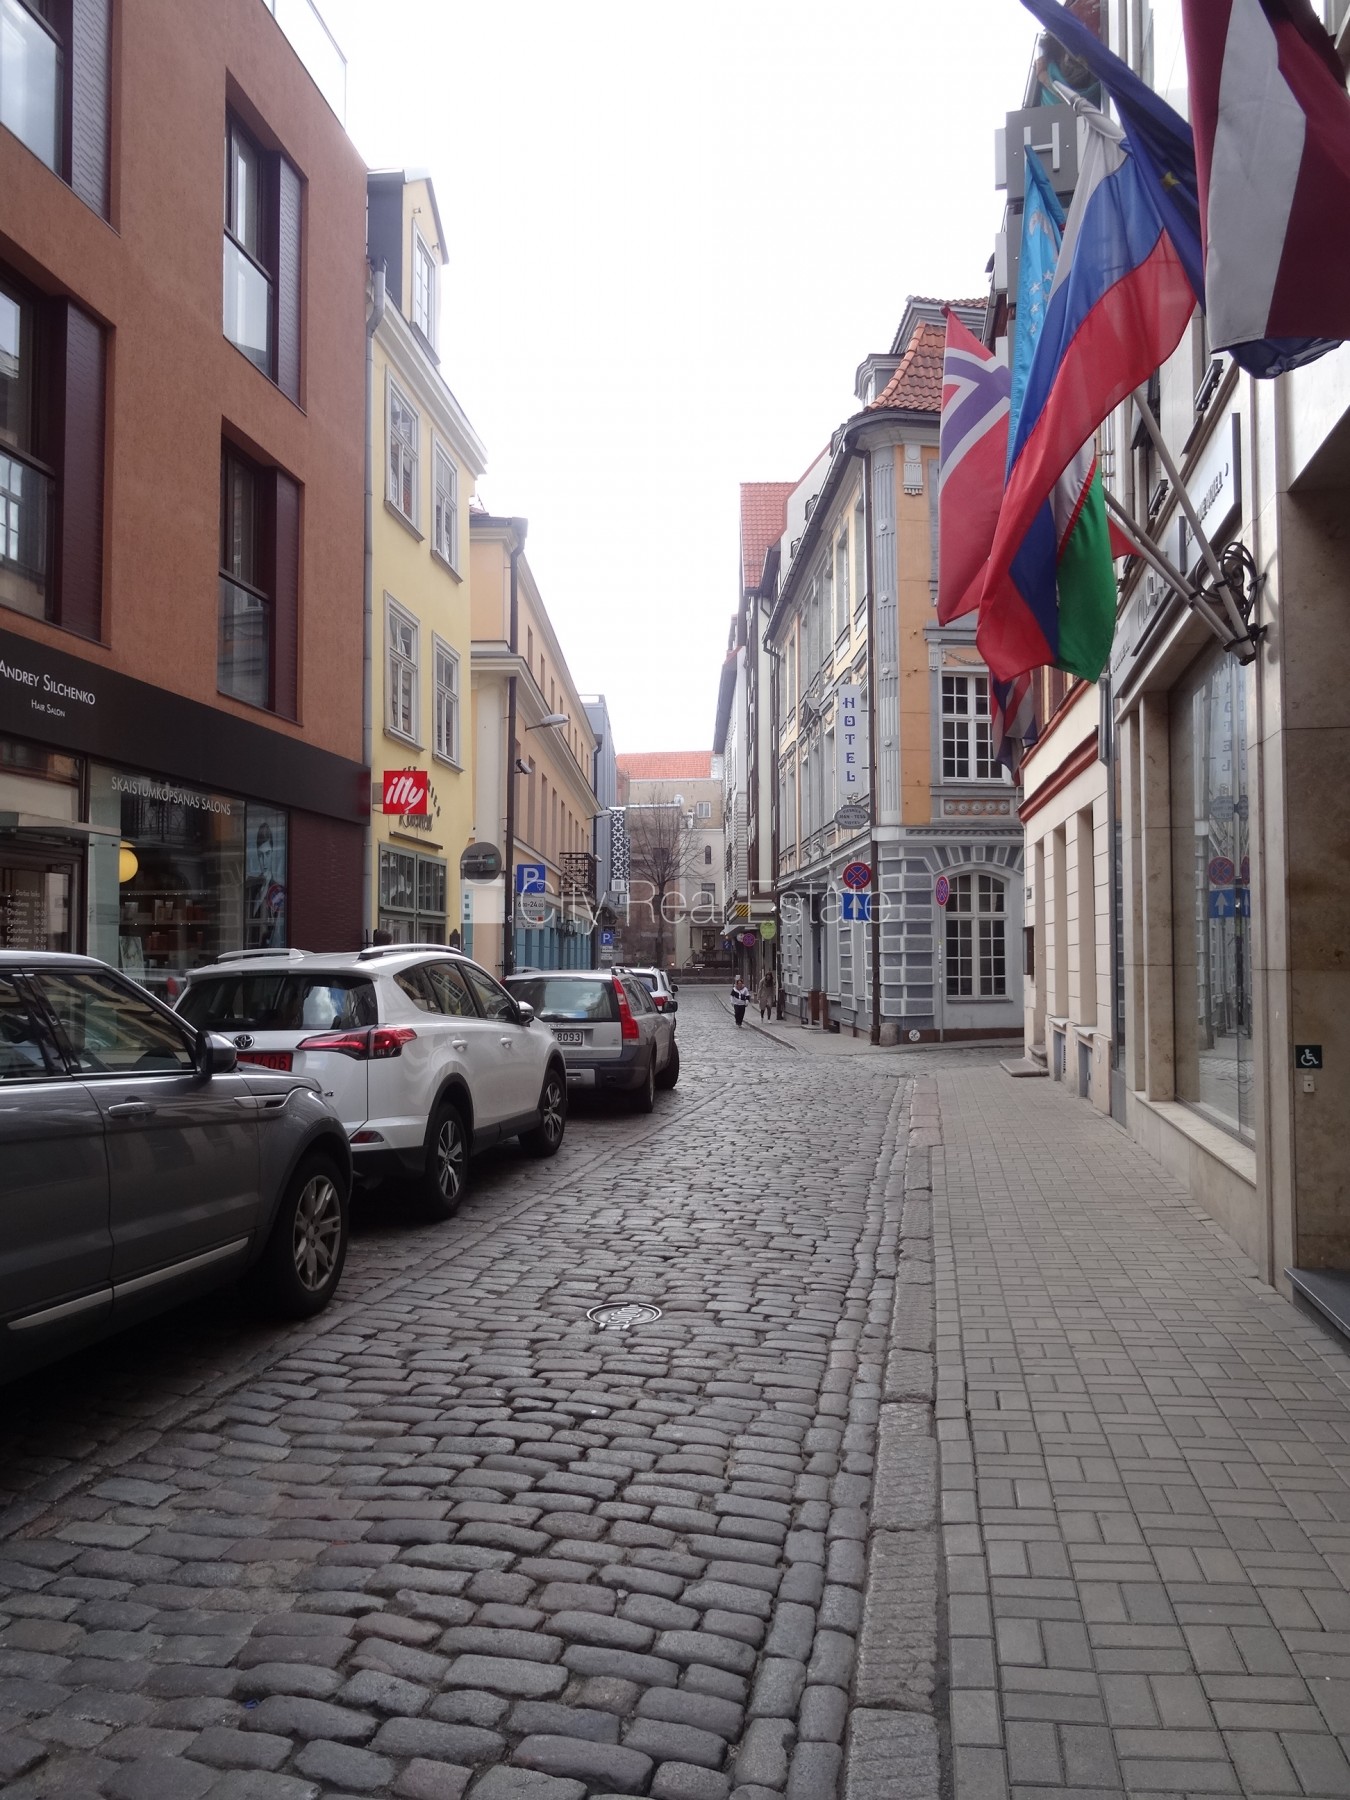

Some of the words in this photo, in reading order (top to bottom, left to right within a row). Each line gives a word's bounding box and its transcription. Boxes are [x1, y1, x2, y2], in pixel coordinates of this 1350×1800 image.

[0, 659, 39, 686] ANDREY
[43, 674, 95, 705] SILCHENKO
[31, 698, 46, 712] HAIR
[46, 703, 66, 717] SALON
[843, 697, 856, 782] HOTEL
[385, 775, 425, 812] illy
[201, 798, 231, 816] SALONS
[523, 867, 540, 889] P
[603, 933, 611, 943] P
[557, 1032, 581, 1042] 8093
